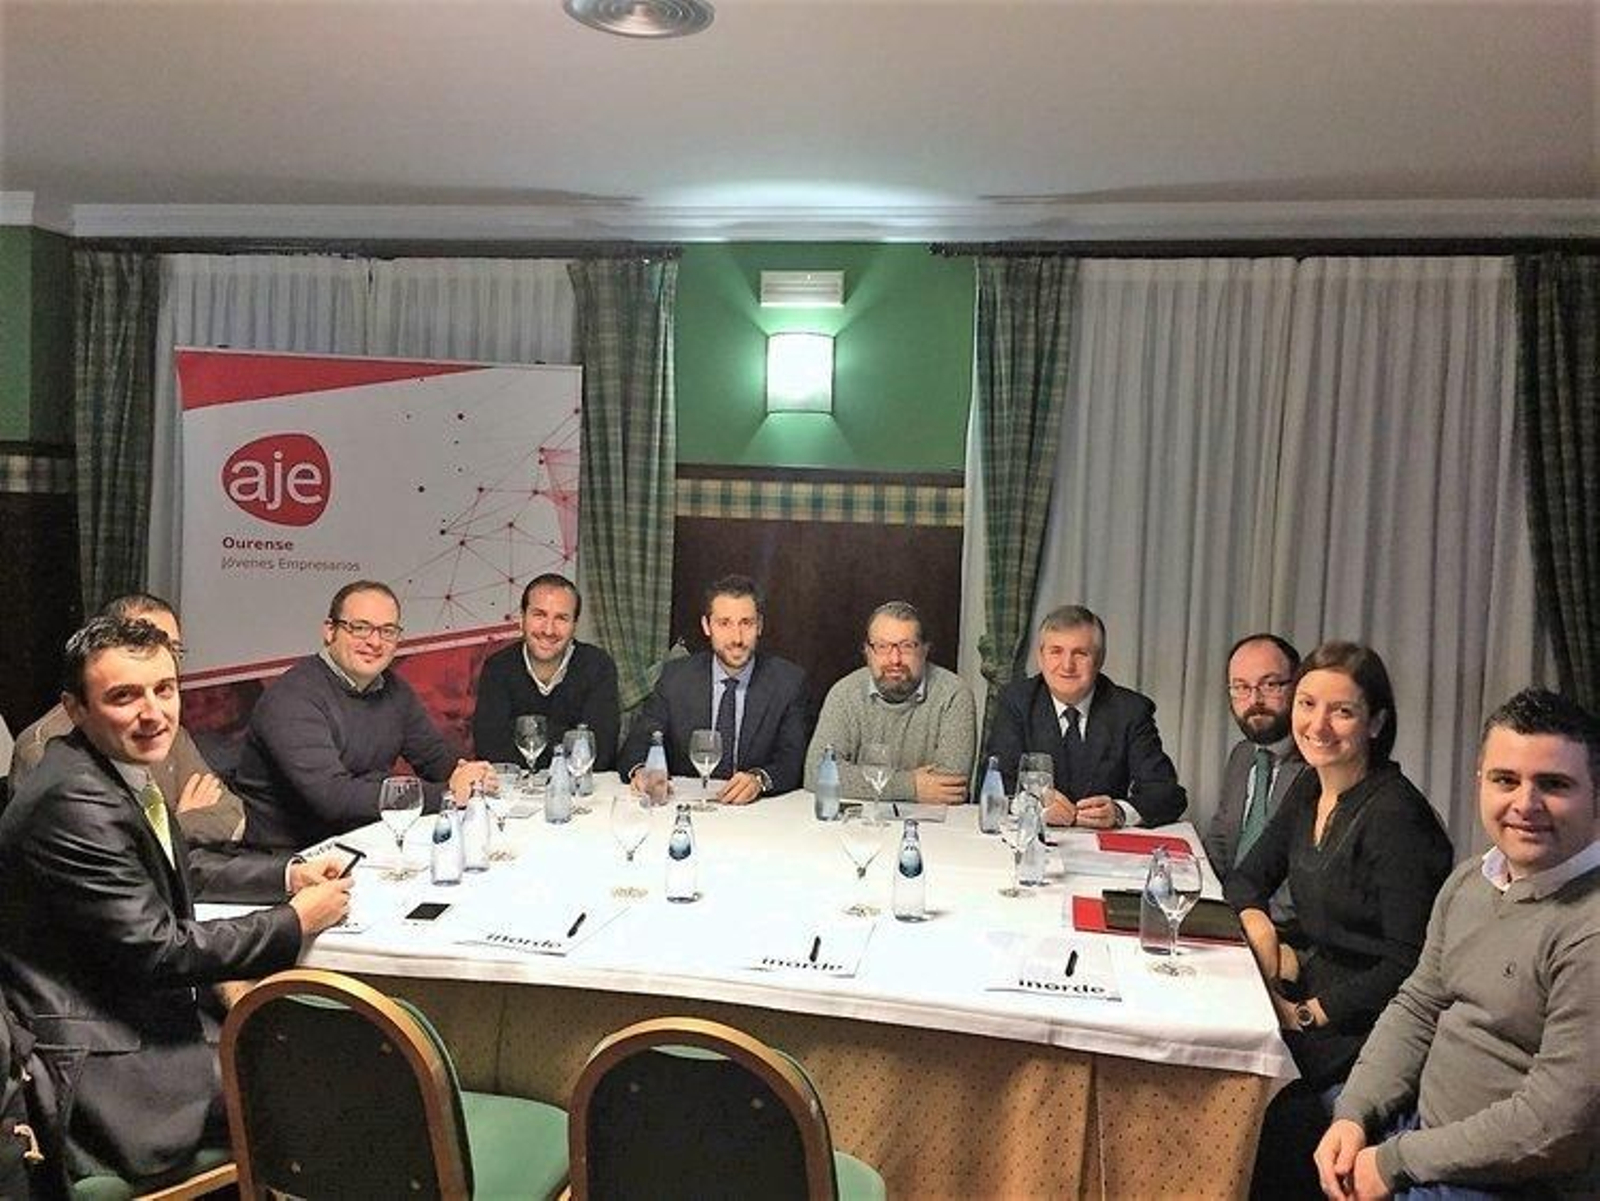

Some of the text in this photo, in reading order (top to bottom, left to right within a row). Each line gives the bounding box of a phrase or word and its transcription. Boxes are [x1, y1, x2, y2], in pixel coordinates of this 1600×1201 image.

[229, 450, 323, 511] aje
[222, 536, 295, 551] Ourense
[221, 556, 361, 572] Jóvenes Empresarios
